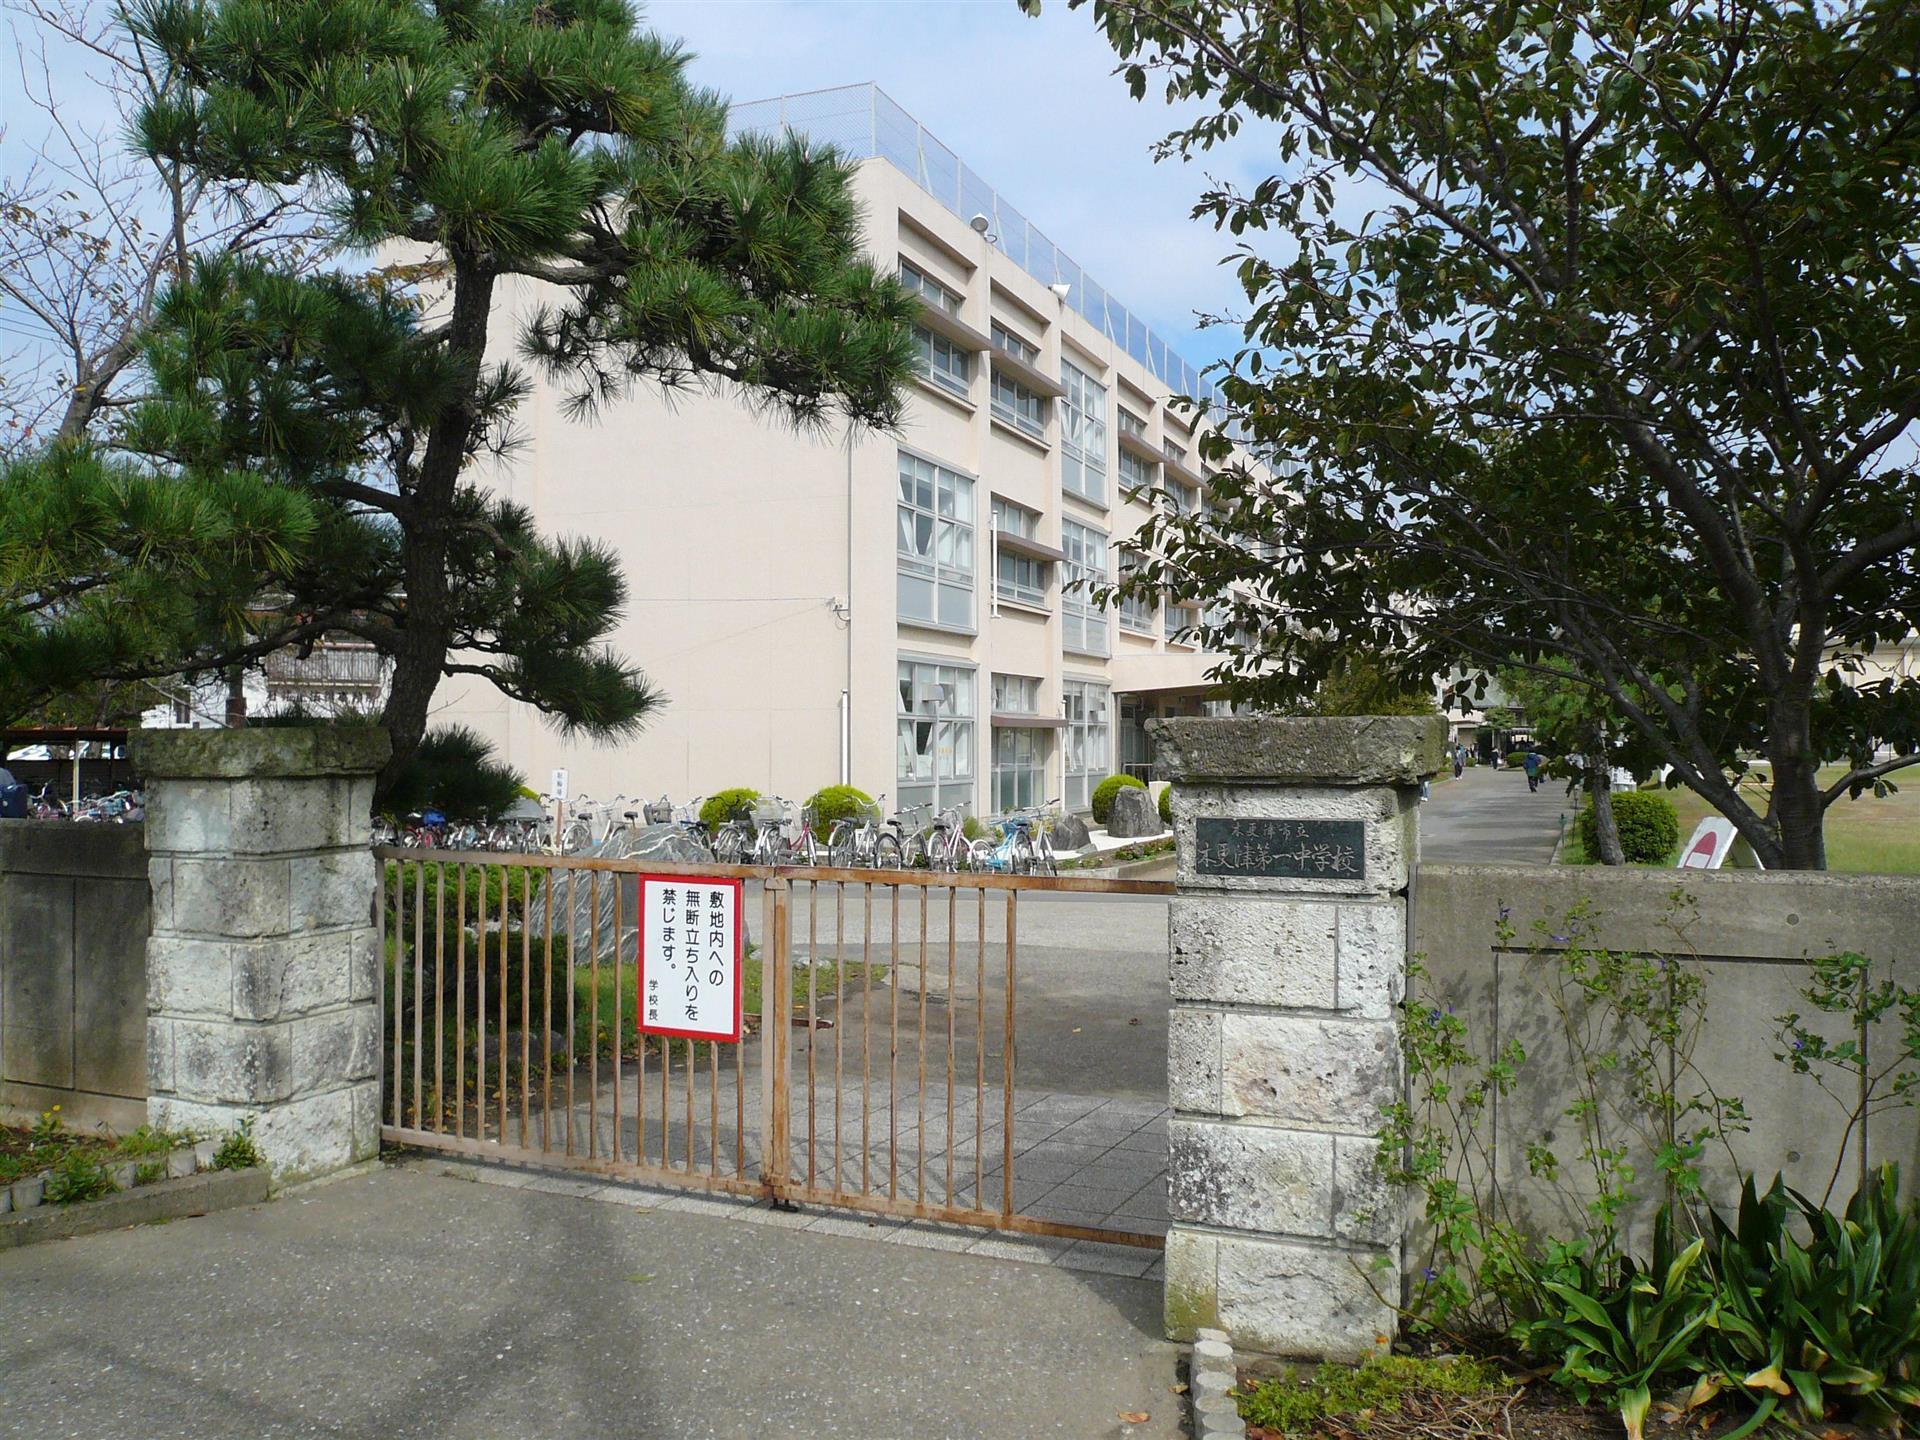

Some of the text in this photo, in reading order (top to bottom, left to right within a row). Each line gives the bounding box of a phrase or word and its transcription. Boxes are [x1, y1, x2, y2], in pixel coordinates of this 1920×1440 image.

[1198, 842, 1359, 873] 木更津第一中学校
[1232, 822, 1309, 840] 木更津市立
[662, 888, 677, 969] 禁じます。
[685, 889, 700, 1021] 無断立ち入りを
[709, 891, 724, 986] 敷地内への
[648, 979, 659, 1021] 学校長
